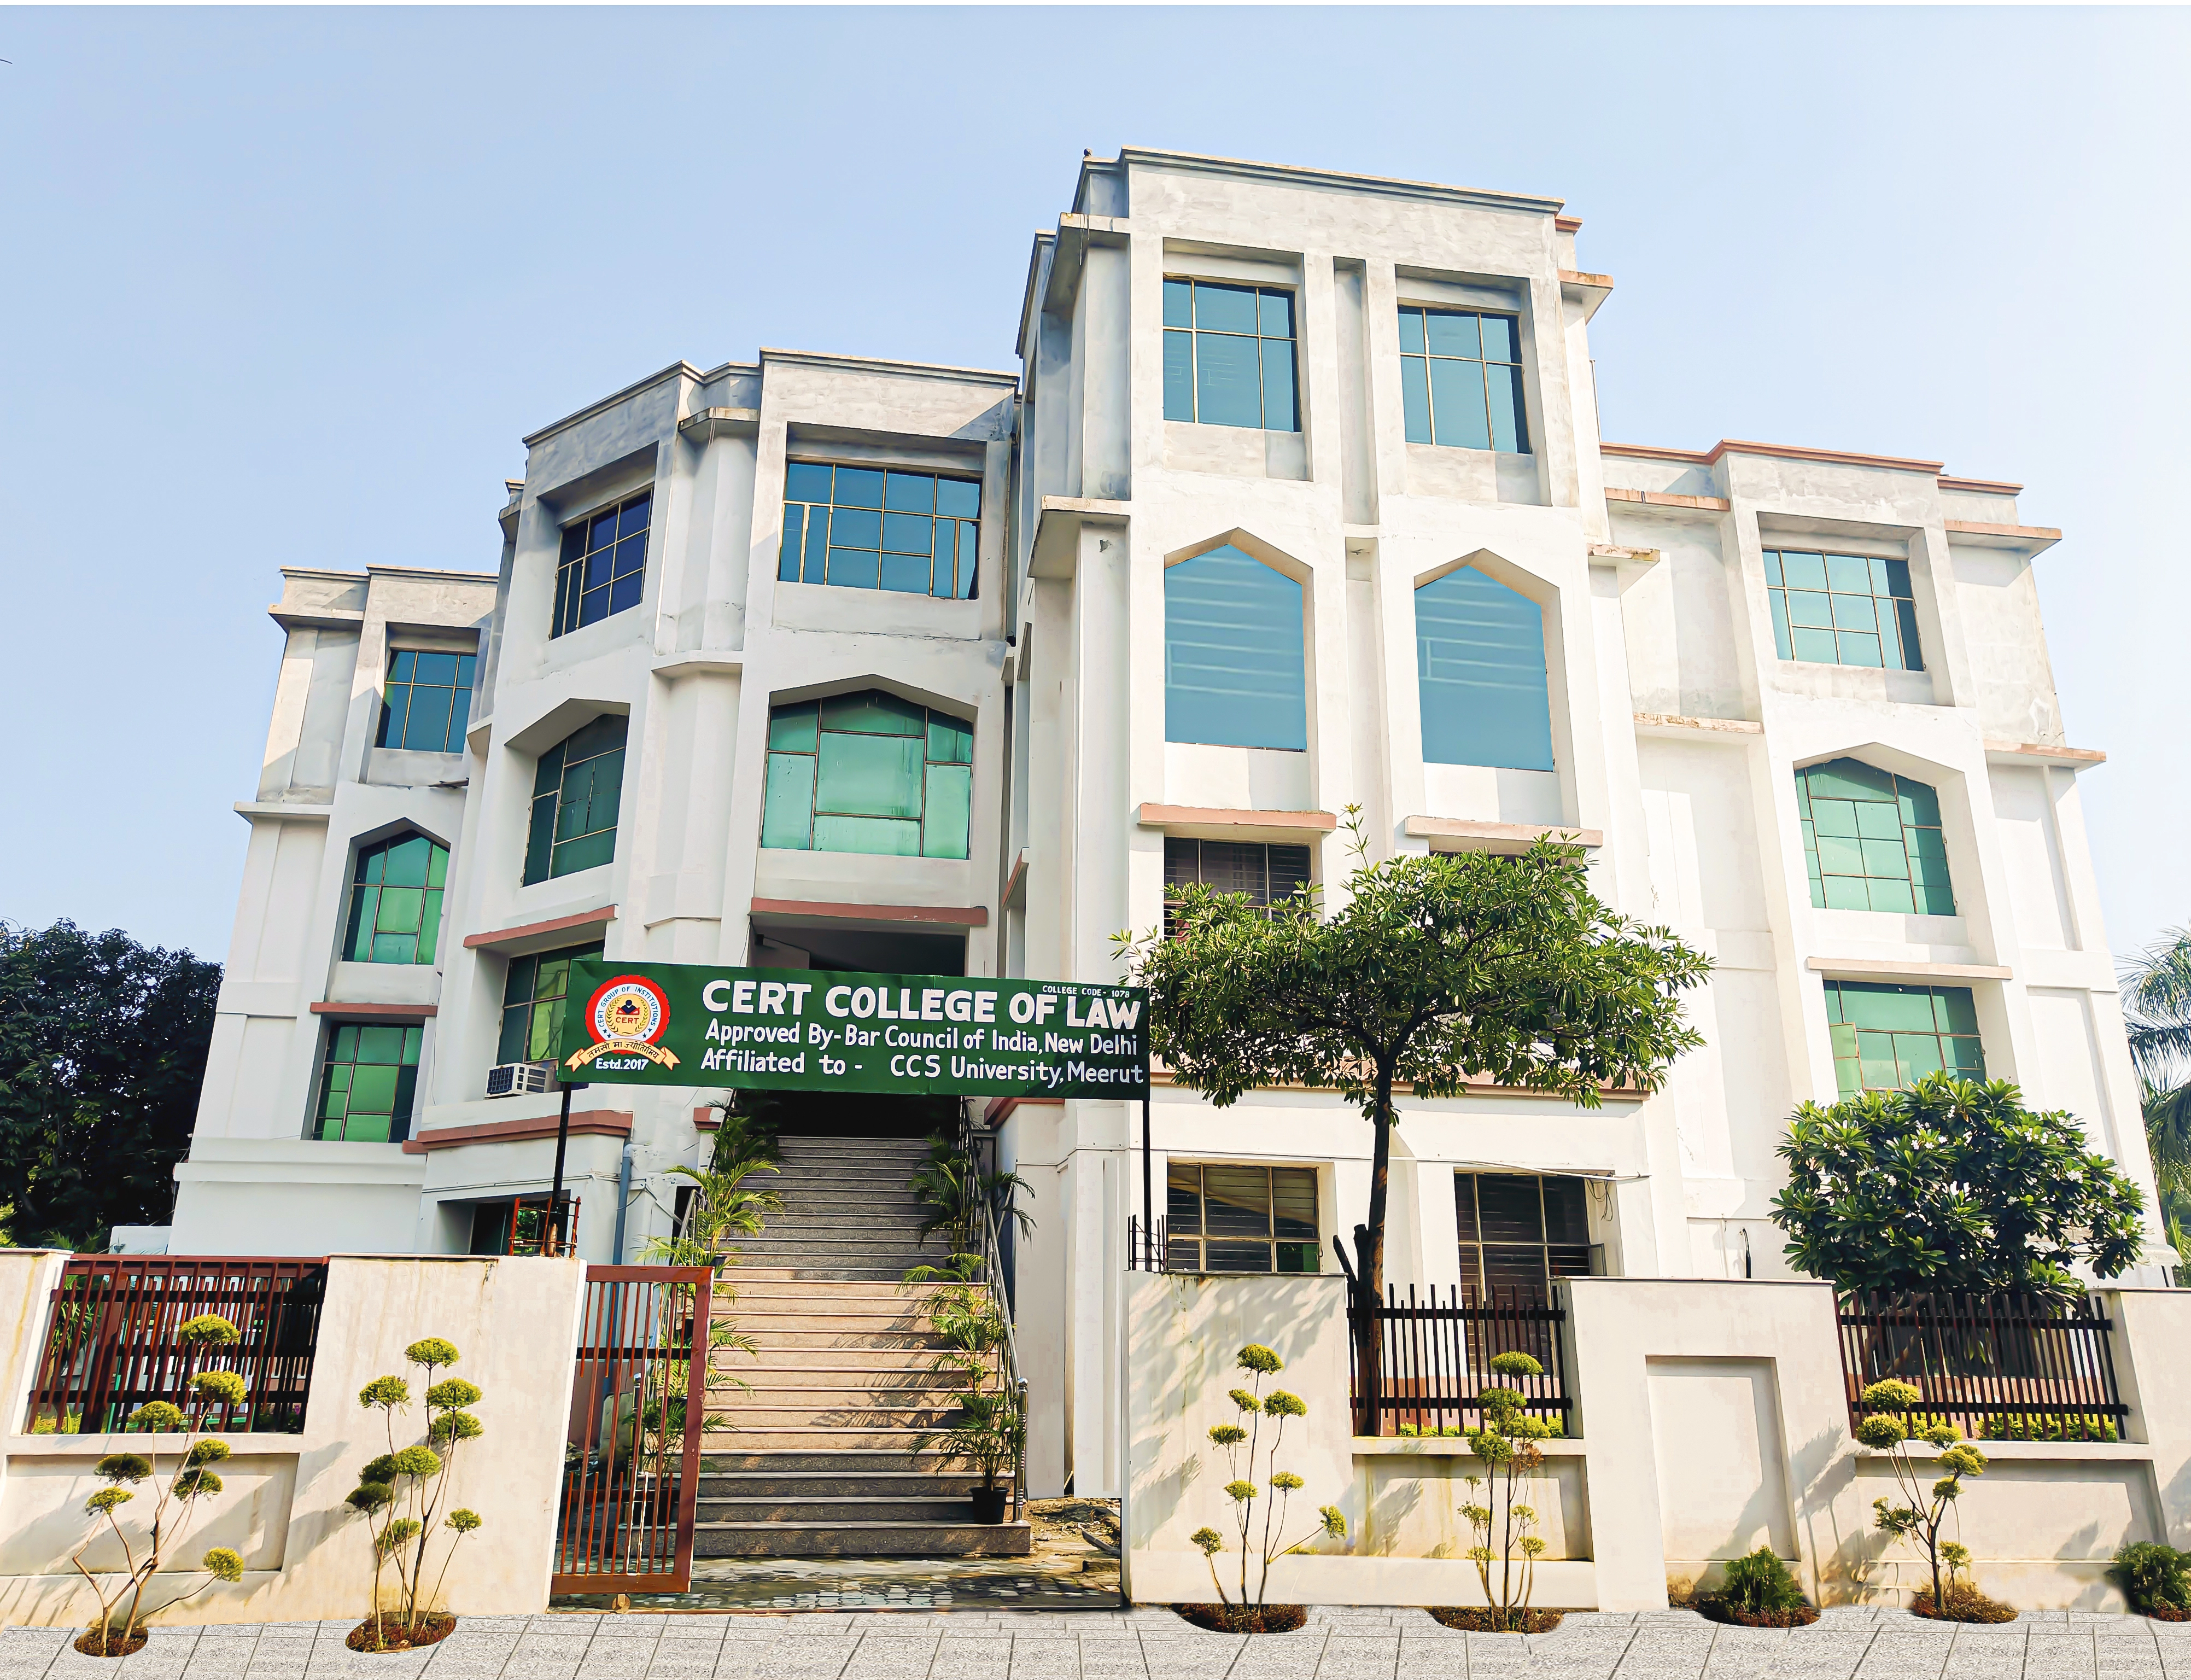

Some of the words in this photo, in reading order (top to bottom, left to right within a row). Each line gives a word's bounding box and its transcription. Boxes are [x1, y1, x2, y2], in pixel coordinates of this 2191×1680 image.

[601, 989, 619, 1007] GROUP
[635, 986, 658, 1026] INSTITUTIONS
[702, 979, 811, 1015] CERT
[825, 985, 998, 1023] COLLEGE
[1009, 992, 1057, 1025] OF
[1066, 995, 1141, 1030] LAW
[1042, 985, 1077, 995] COLLEGE
[1112, 990, 1130, 998] 1078
[705, 1018, 801, 1047] Approved
[885, 1025, 959, 1050] Council
[963, 1029, 985, 1049] of
[1090, 1034, 1137, 1055] Delhi
[700, 1047, 805, 1073] Affiliated
[819, 1054, 846, 1075] to
